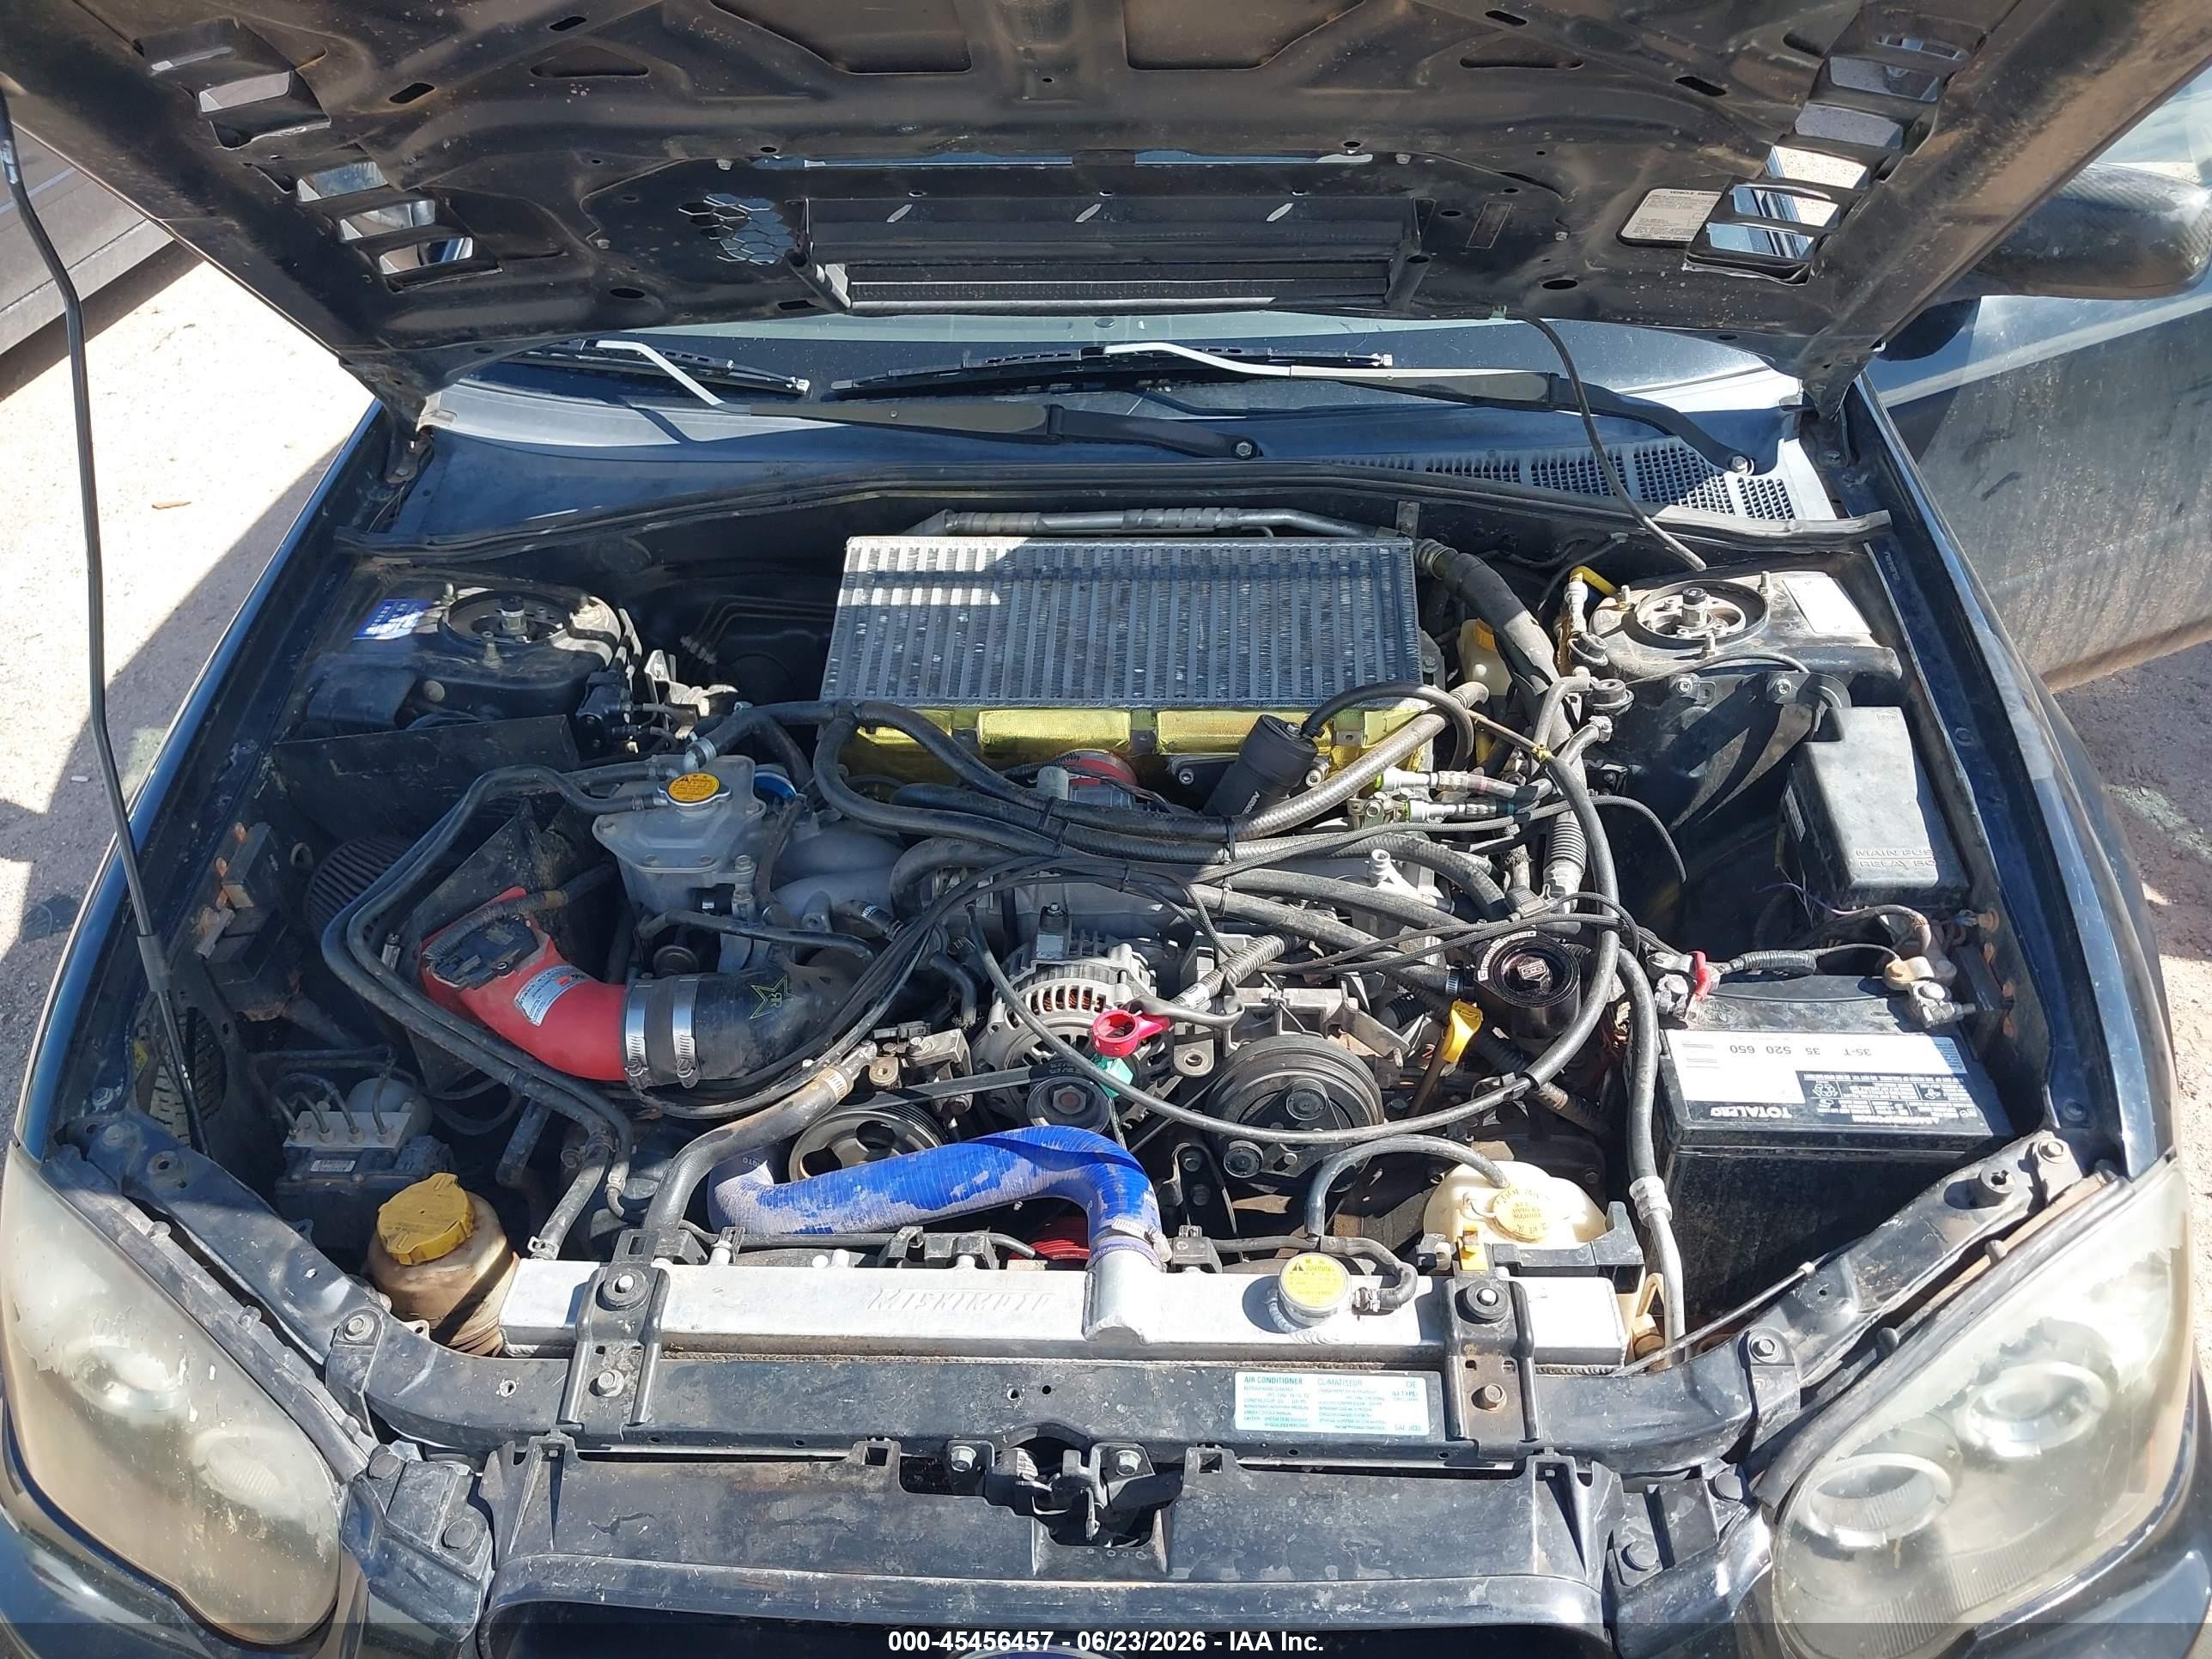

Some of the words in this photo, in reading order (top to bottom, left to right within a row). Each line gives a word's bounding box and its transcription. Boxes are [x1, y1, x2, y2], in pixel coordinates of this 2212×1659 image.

[1855, 848, 1897, 857] MAIN
[1901, 848, 1934, 857] FUS
[1729, 1043, 1756, 1054] 650
[1765, 1044, 1793, 1055] 520
[1805, 1046, 1820, 1056] 35
[1842, 1047, 1872, 1057] 35-T
[1257, 1376, 1303, 1385] CONDITIONER
[1317, 1378, 1363, 1387] CLIMATISEUR
